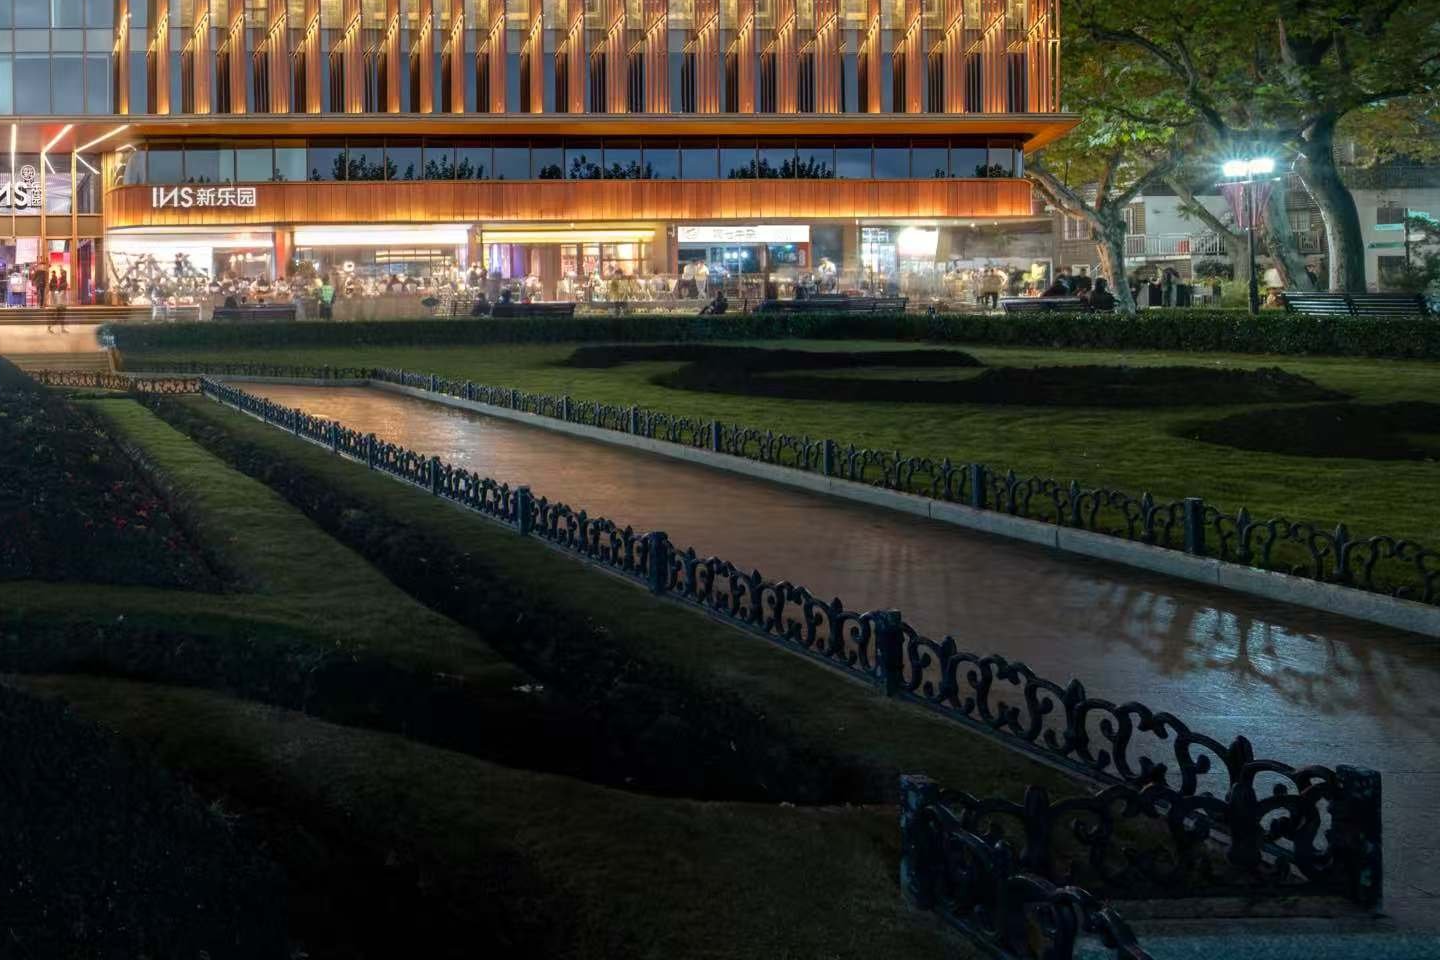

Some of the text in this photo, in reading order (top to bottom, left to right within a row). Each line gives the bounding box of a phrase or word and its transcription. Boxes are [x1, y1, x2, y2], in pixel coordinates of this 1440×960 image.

[152, 186, 256, 208] INS 新乐园
